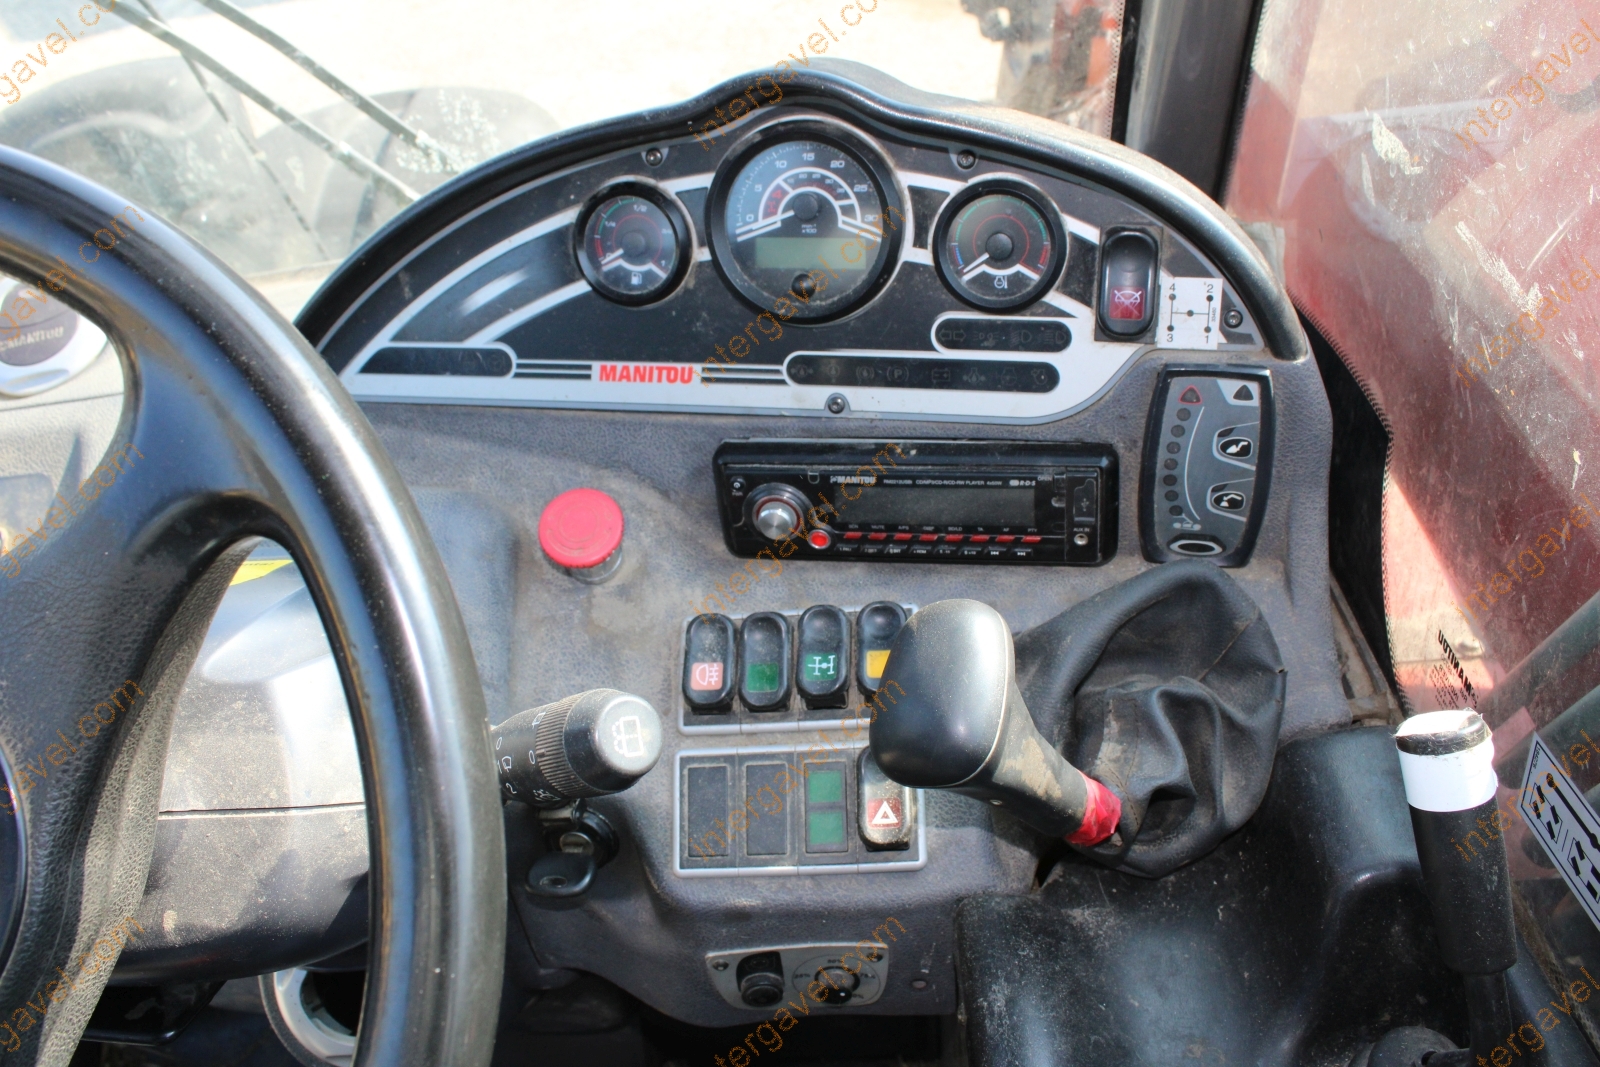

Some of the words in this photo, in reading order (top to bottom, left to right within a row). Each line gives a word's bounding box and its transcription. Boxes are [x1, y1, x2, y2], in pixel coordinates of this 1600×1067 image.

[802, 153, 815, 161] 15
[774, 160, 788, 169] 10
[830, 160, 845, 169] 20
[754, 184, 763, 192] 5
[854, 184, 868, 192] 25
[633, 204, 648, 212] 1/2
[746, 213, 754, 222] 0
[864, 214, 879, 222] 30
[1169, 283, 1176, 292] 4
[1206, 283, 1214, 293] 2
[1166, 333, 1174, 343] 3
[1204, 335, 1209, 344] 1
[599, 364, 694, 385] MANITOU
